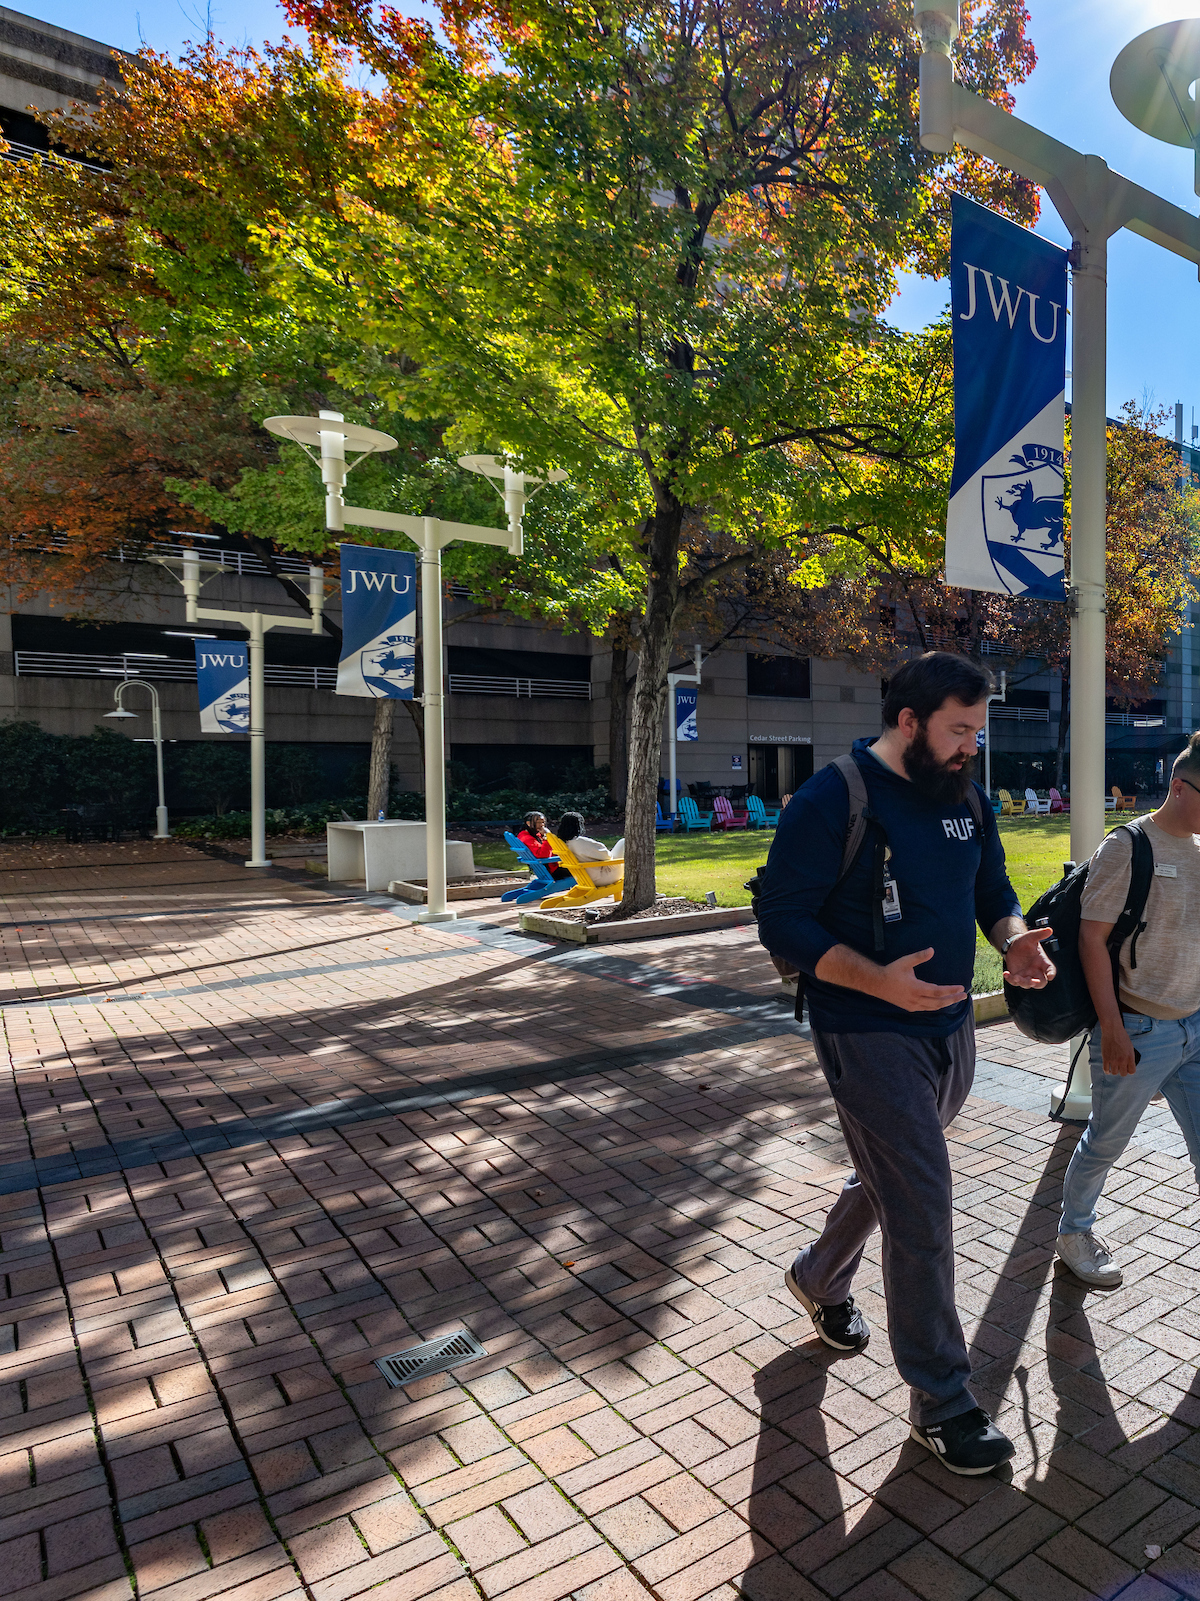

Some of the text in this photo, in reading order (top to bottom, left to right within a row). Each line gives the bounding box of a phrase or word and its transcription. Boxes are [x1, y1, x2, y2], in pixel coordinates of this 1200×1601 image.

[960, 262, 1062, 345] JWU
[1034, 446, 1063, 466] 1914
[346, 569, 412, 594] JWU
[199, 653, 245, 669] JWU
[677, 695, 696, 705] JWU
[789, 735, 811, 744] Parking
[941, 818, 975, 841] RUF
